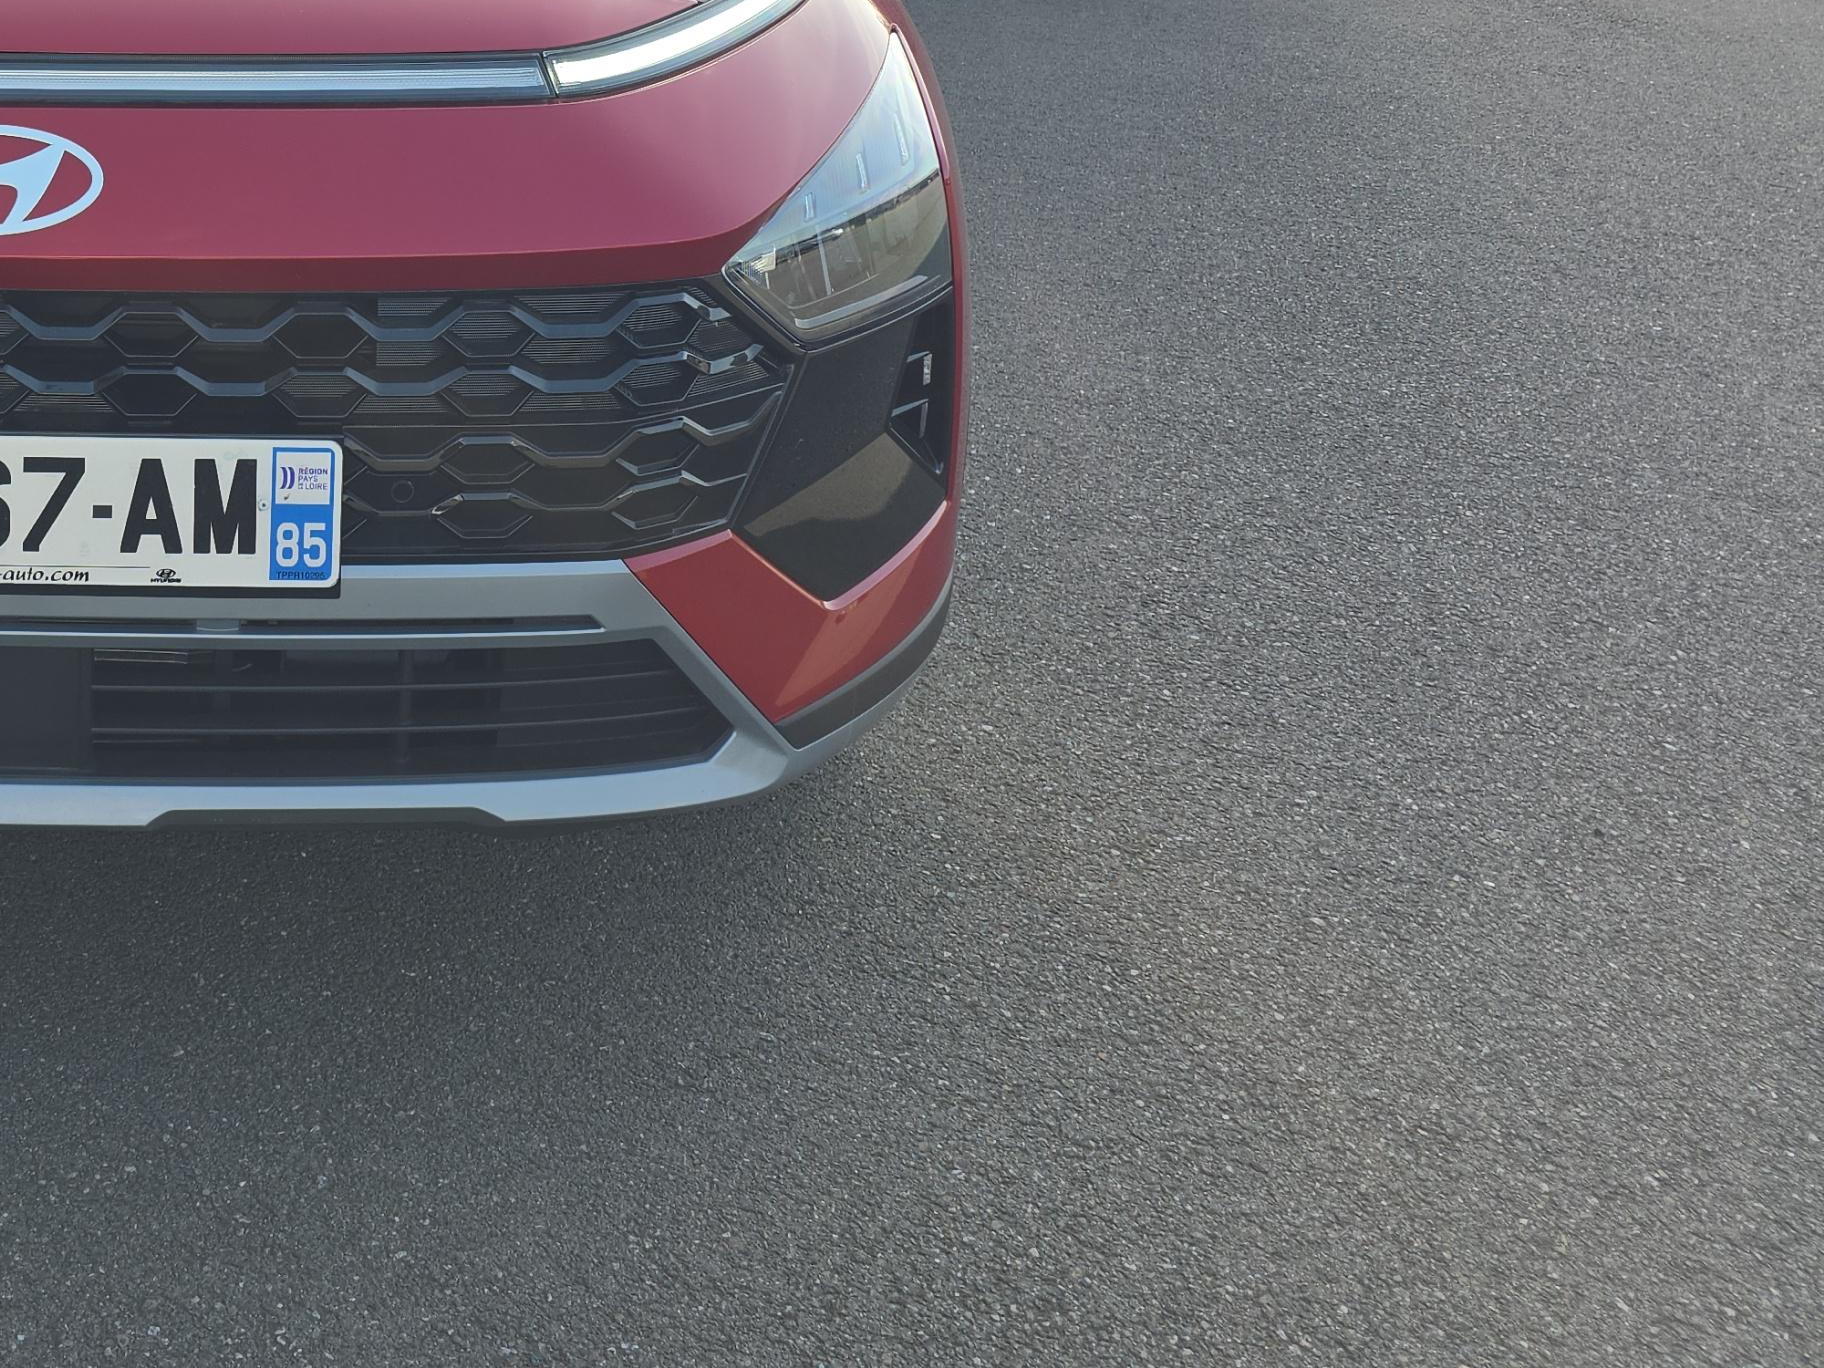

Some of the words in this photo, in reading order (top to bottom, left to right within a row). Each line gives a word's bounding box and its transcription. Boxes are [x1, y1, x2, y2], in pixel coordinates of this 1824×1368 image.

[297, 466, 329, 476] RÉGION
[297, 475, 319, 484] PAYS
[304, 482, 329, 491] LOIRE
[275, 521, 327, 568] 85
